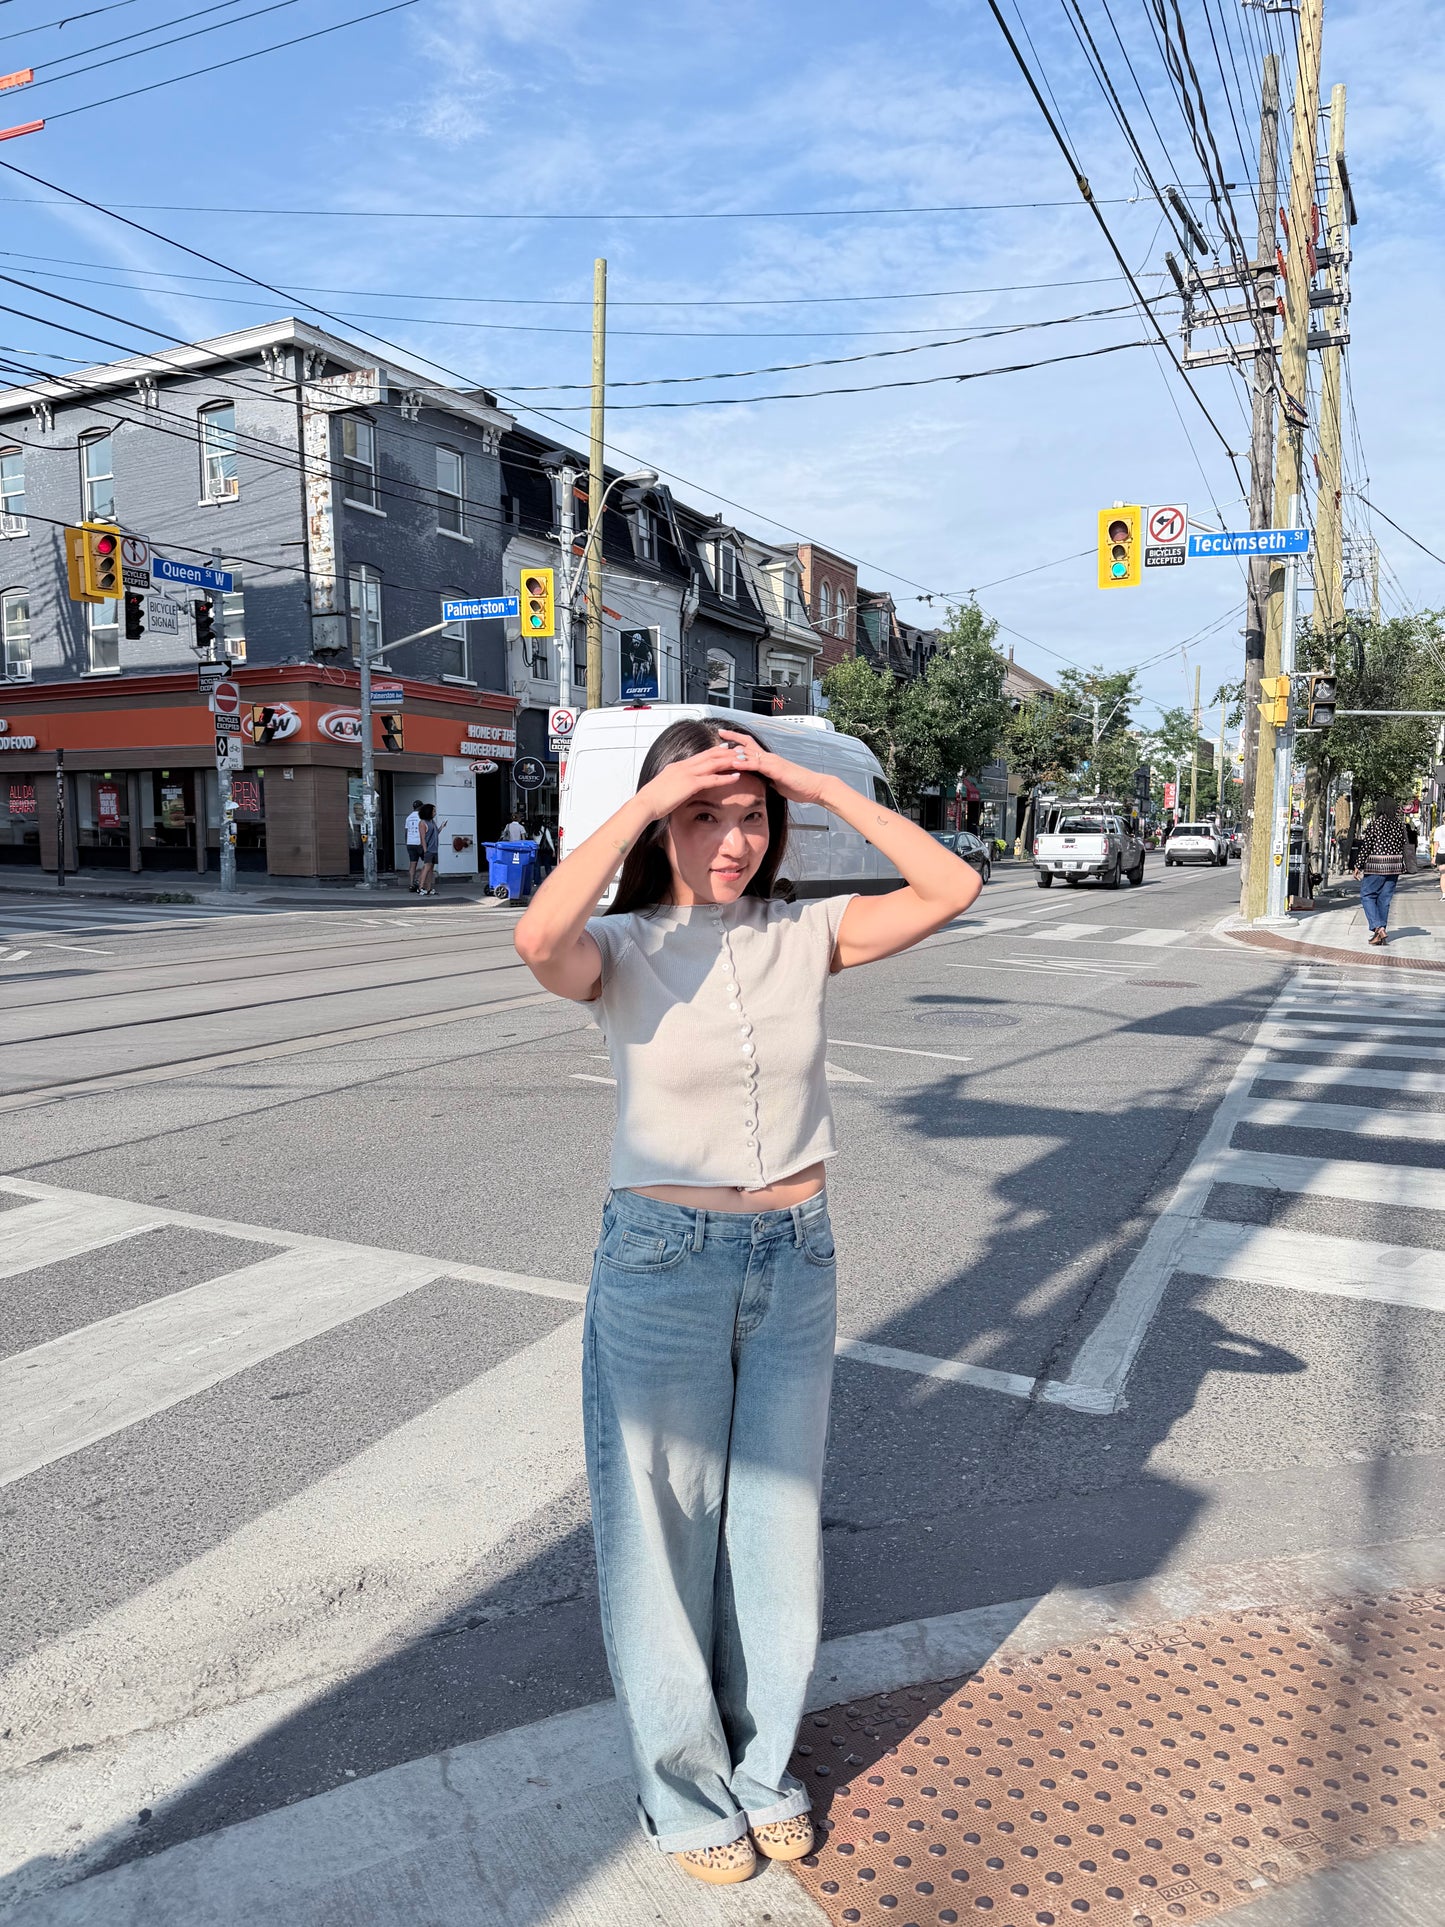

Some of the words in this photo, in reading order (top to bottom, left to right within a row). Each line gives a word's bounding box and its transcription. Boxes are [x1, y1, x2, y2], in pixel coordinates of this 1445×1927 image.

[1193, 532, 1286, 552] Tecumseth
[1294, 531, 1304, 541] St
[1149, 548, 1182, 557] BICYCLES
[1147, 556, 1183, 565] EXCEPTED
[162, 562, 201, 581] Queen
[205, 569, 212, 578] St
[214, 572, 225, 586] W
[124, 577, 149, 588] XCEPTED
[149, 601, 177, 616] BICYCLE
[446, 601, 505, 617] Palmerston
[151, 616, 176, 630] SIGNAL
[468, 724, 491, 740] HOME
[491, 728, 502, 741] OF
[502, 729, 516, 742] THE
[10, 735, 36, 750] FOOD
[460, 741, 491, 757] BURGER
[491, 744, 516, 759] FAMILY
[9, 785, 21, 799] ALL
[1162, 1881, 1195, 1898] 2025
